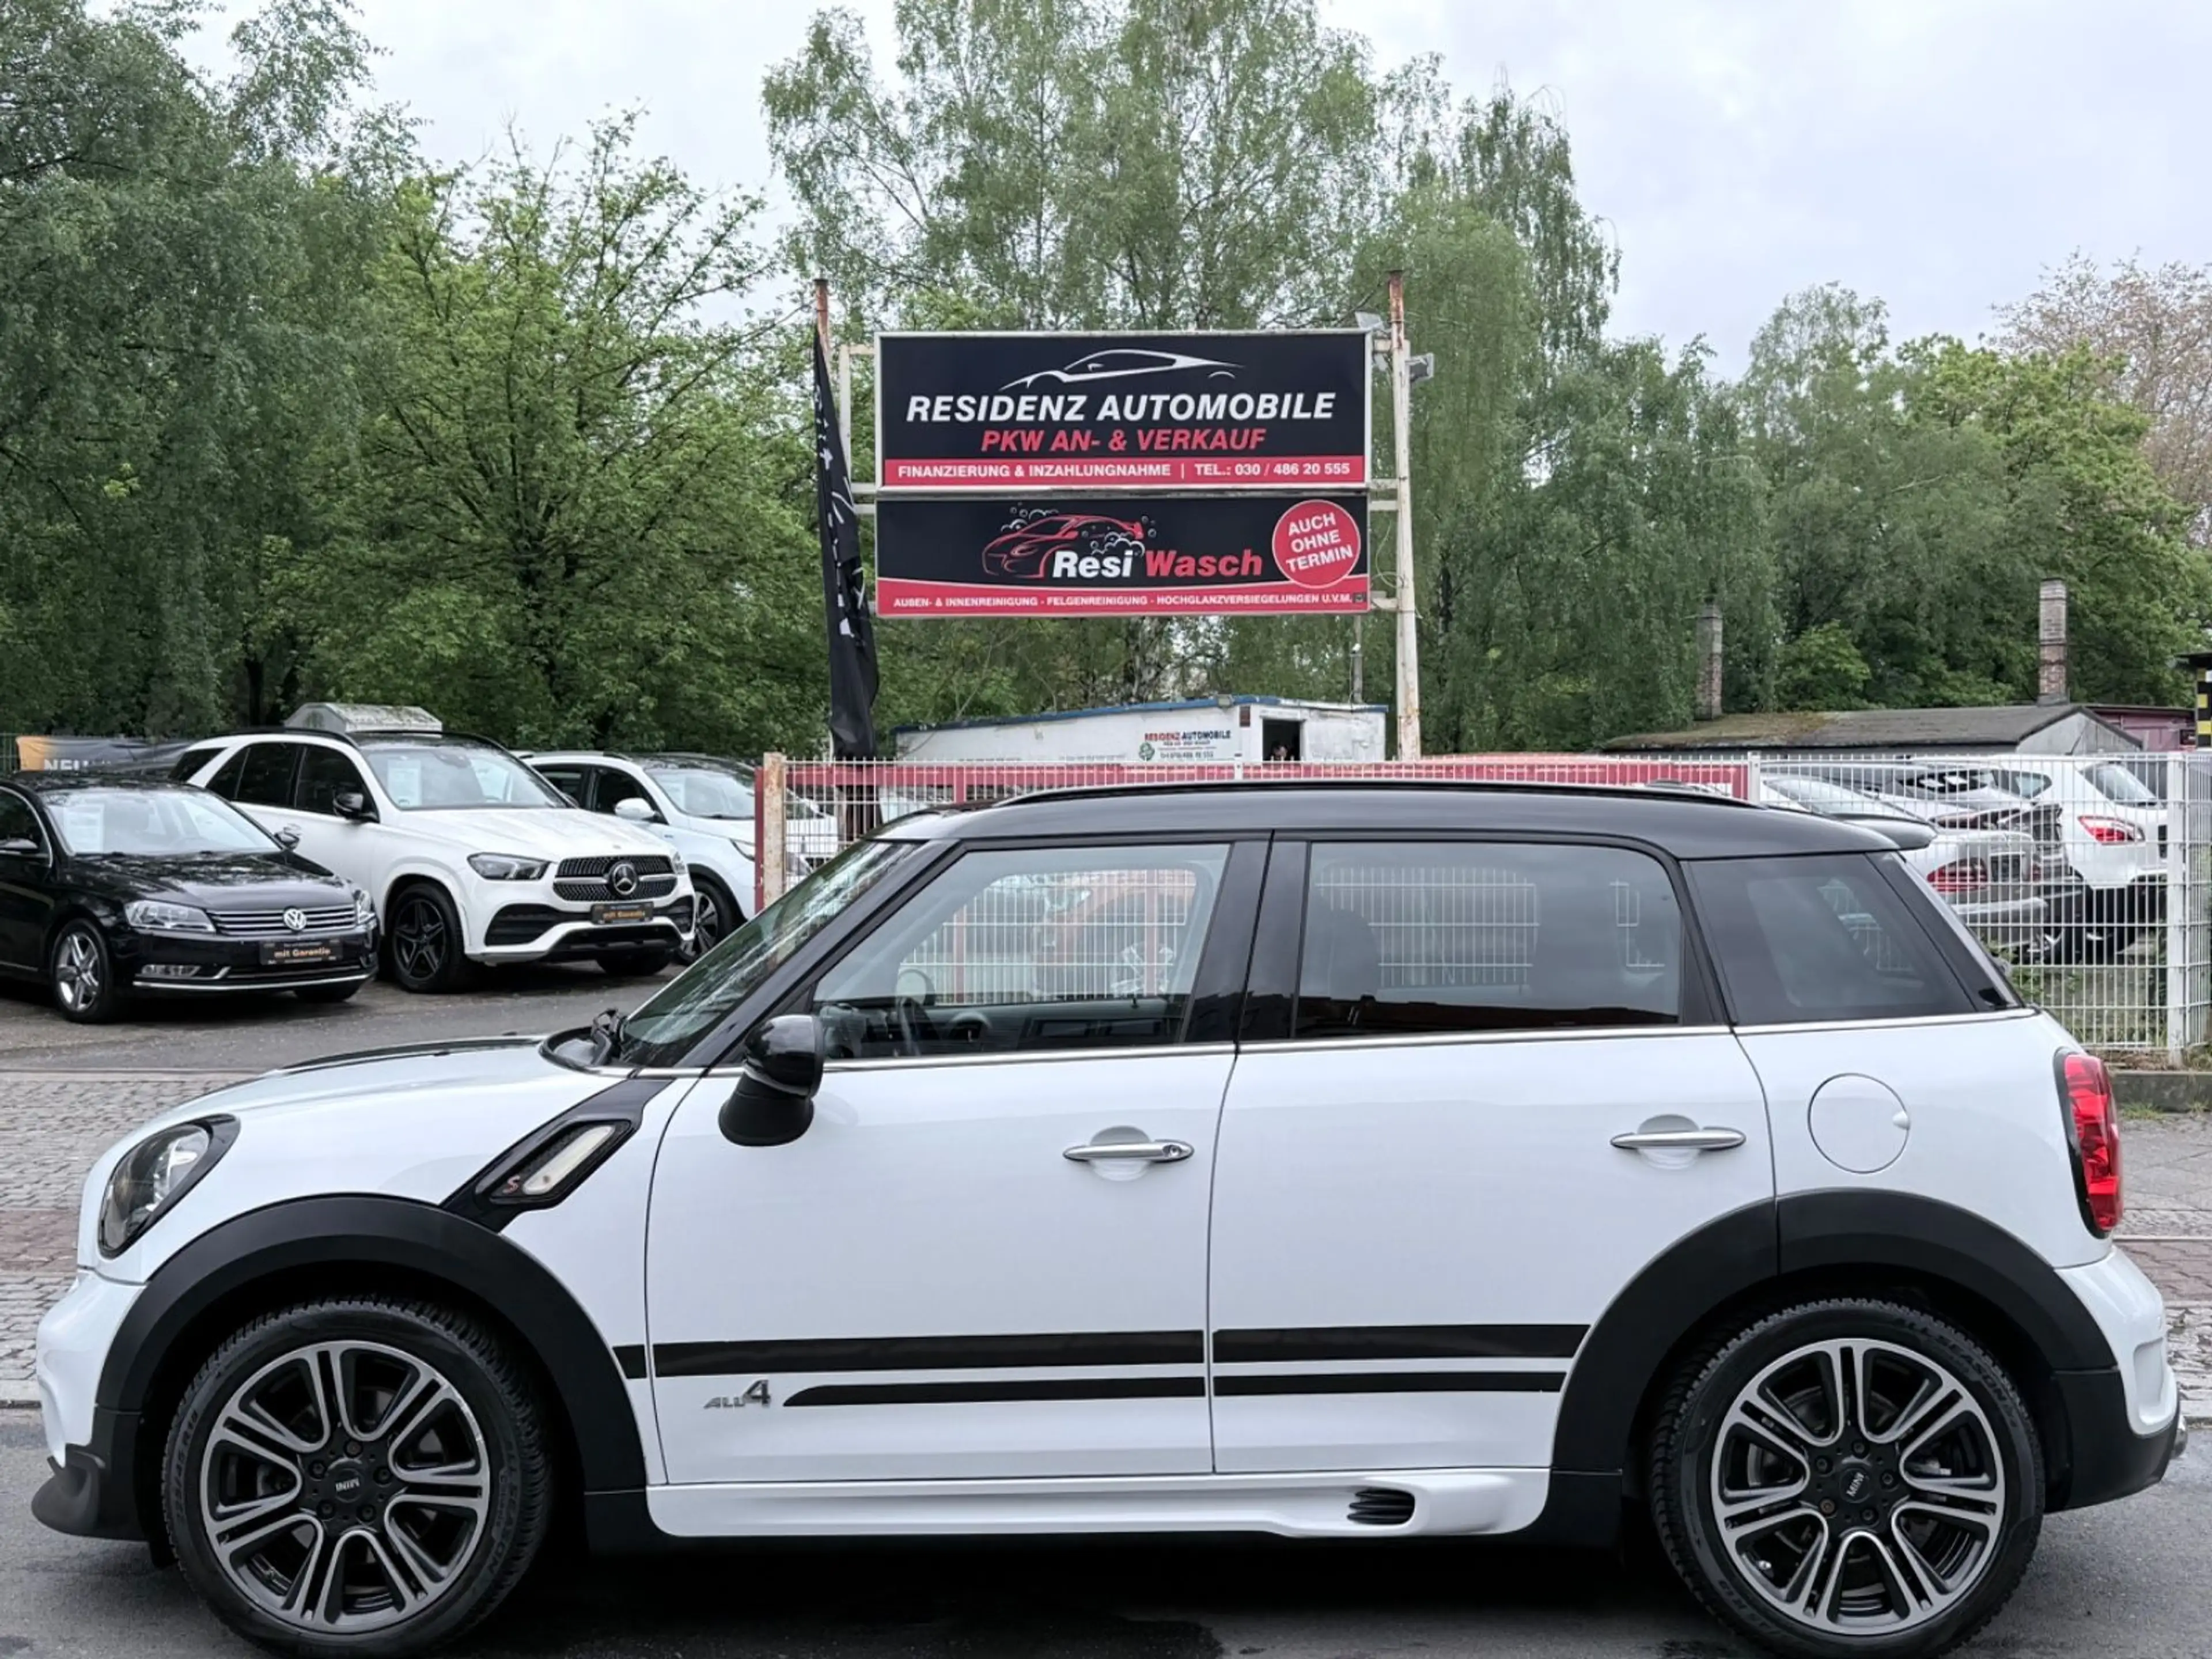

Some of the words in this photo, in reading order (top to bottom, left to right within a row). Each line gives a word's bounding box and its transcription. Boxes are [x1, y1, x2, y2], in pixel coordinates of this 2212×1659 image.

[906, 395, 1088, 422] RESIDENZ
[1096, 392, 1336, 422] AUTOMOBILE
[981, 429, 1045, 452] PKW
[1050, 429, 1101, 452] AN-
[1108, 429, 1127, 452] &
[1137, 428, 1266, 450] VERKAUF
[898, 464, 1010, 478] FINANZIERUNG
[1014, 464, 1025, 478] &
[1029, 463, 1171, 477] INZAHLUNGNAHME
[1194, 463, 1232, 476] TEL.:
[1234, 463, 1261, 476] 030
[1273, 463, 1299, 475] 486
[1303, 462, 1320, 475] 20
[1324, 462, 1350, 475] 555
[1289, 512, 1336, 536] AUCH
[1291, 529, 1341, 553] OHNE
[1052, 550, 1133, 578] Resi
[1145, 548, 1263, 577] Wasch
[1286, 544, 1353, 573] TERMIN
[946, 596, 1038, 607] INNENREINIGUNG
[1047, 596, 1147, 606] FELGENREINIGUNG
[1157, 594, 1319, 605] HOCHGLANZVERSIEGELUNGEN
[1181, 730, 1232, 740] AUTOMOBILE
